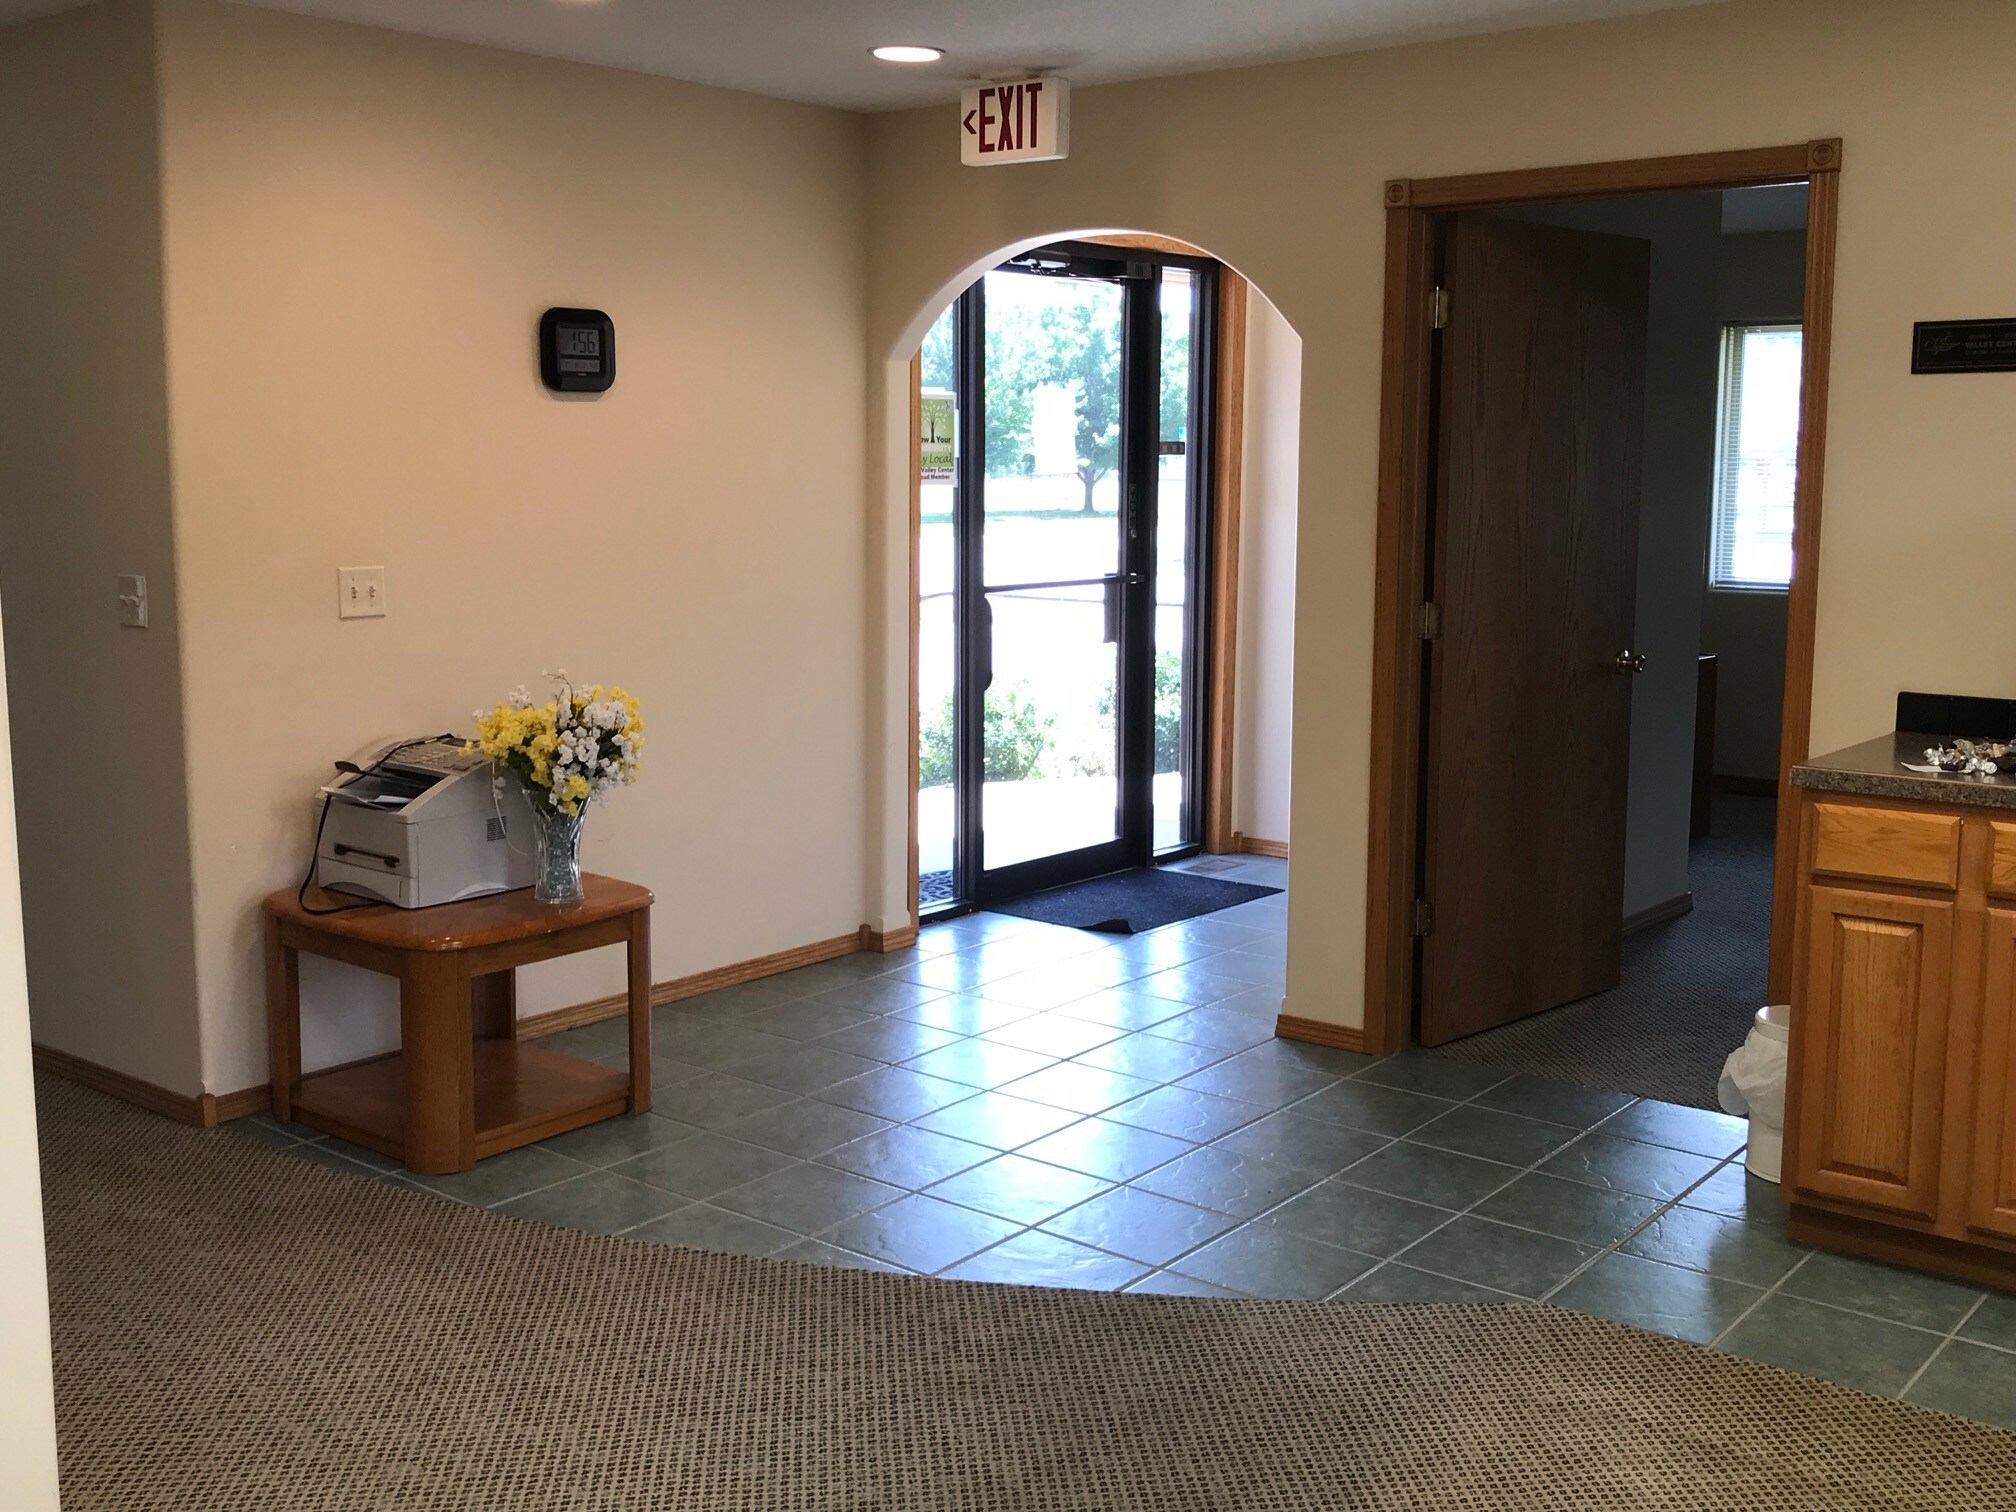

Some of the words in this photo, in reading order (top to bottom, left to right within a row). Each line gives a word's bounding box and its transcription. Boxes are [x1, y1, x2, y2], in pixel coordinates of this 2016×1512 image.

[979, 82, 1043, 153] EXIT
[936, 435, 951, 443] Your
[929, 453, 953, 466] Local
